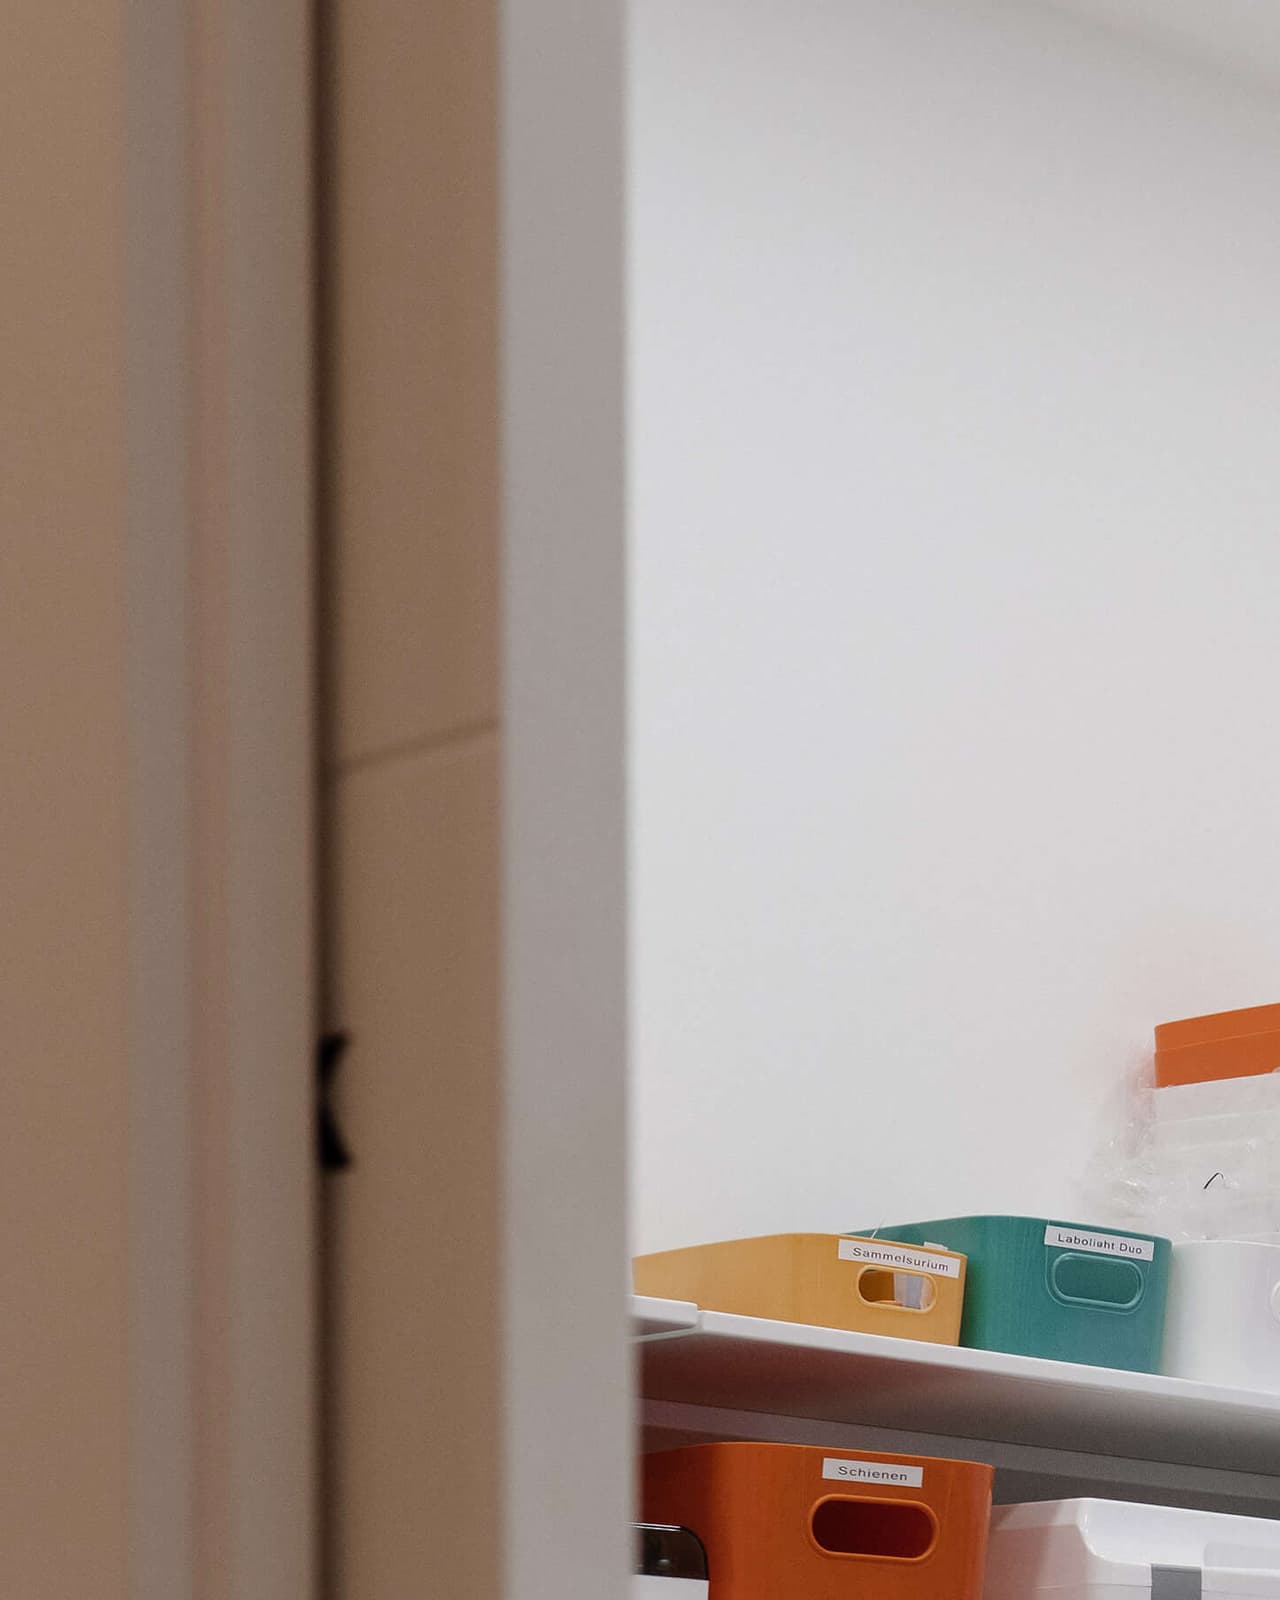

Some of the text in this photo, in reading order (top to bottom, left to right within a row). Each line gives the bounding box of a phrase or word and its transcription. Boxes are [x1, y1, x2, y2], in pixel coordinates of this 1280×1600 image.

[1117, 1240, 1143, 1255] Duo
[853, 1246, 950, 1272] Sammelsurium
[838, 1465, 909, 1481] Schienen
